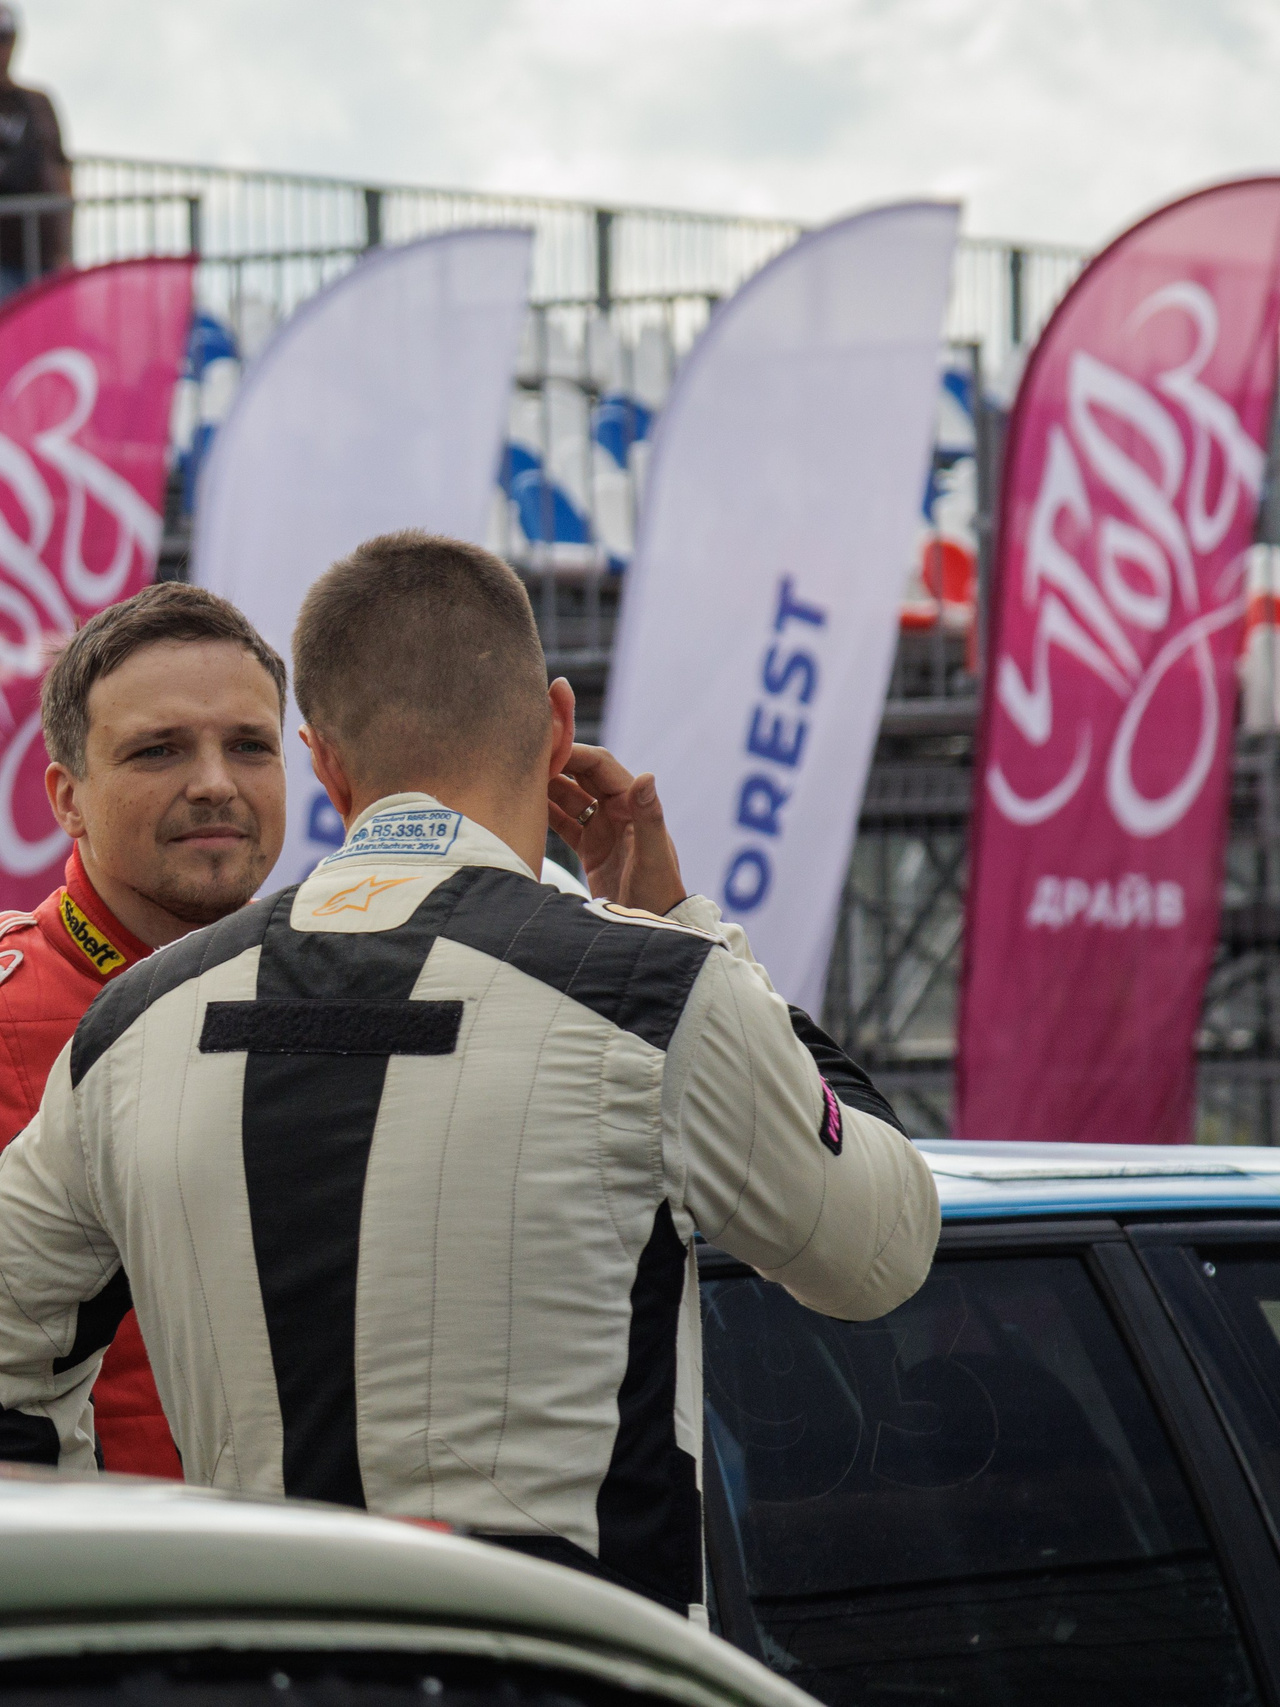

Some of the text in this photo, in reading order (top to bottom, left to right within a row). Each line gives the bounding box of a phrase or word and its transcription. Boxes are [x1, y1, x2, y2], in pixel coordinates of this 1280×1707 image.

[723, 572, 828, 916] OREST
[371, 822, 447, 837] RS.336.18
[65, 900, 120, 968] Sabelt
